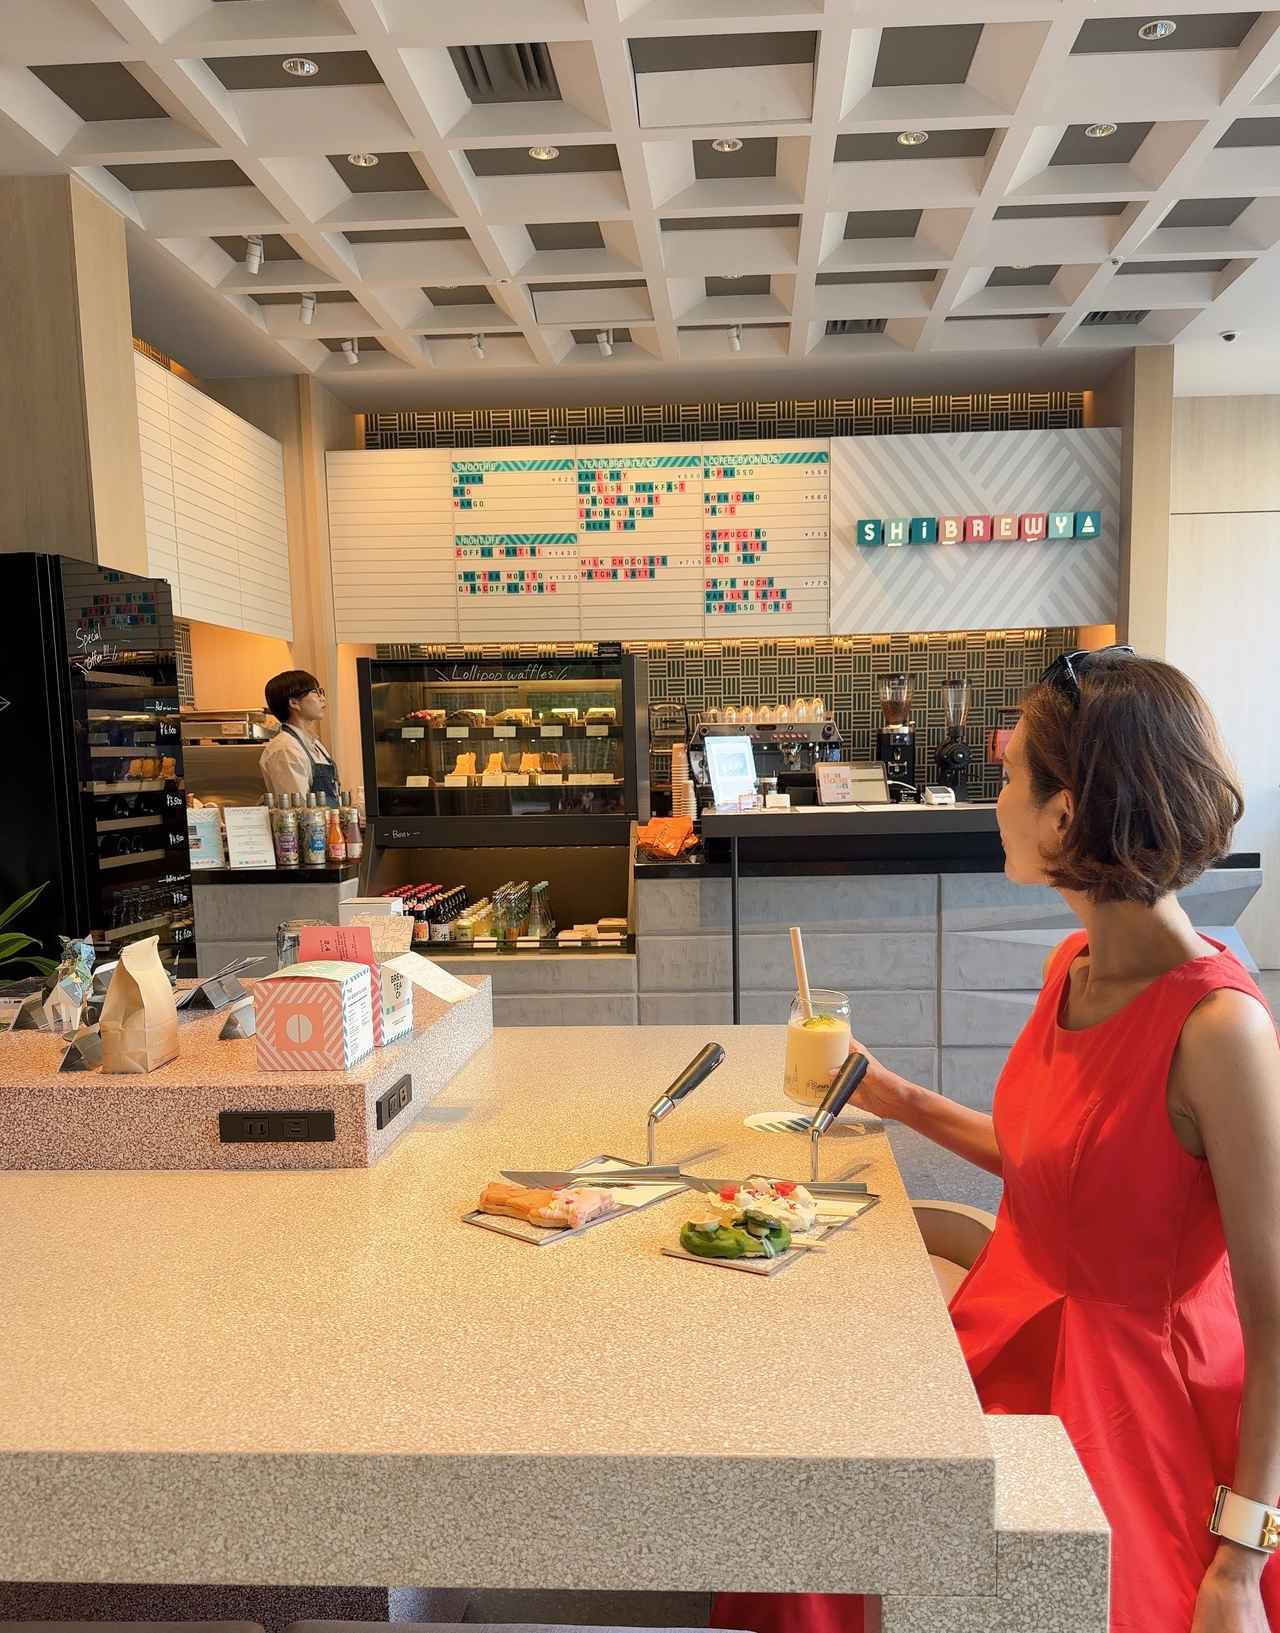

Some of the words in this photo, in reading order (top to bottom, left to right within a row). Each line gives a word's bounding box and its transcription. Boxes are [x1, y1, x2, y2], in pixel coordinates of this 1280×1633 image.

[709, 456, 738, 465] COFFEE
[704, 467, 754, 478] ESPRESSO
[453, 473, 484, 485] GREEN
[453, 486, 471, 497] RED
[578, 483, 623, 494] ENGLISH
[629, 481, 686, 493] BREAKFAST
[578, 495, 628, 506] MOROCCAN
[635, 494, 660, 506] MINT
[704, 492, 760, 503] AMERICANO
[454, 498, 484, 509] MANGO
[704, 505, 736, 516] MAGIC
[580, 520, 610, 531] GREEN
[617, 519, 636, 531] TEA
[705, 528, 767, 540] CAPPUCCINO
[456, 546, 493, 557] COFFEE
[499, 546, 543, 557] MARTINI
[735, 541, 767, 552] LATTE
[580, 557, 604, 567] MILK
[611, 556, 668, 567] CHOCOLATE
[705, 554, 729, 565] COLD
[736, 553, 761, 564] BREW
[506, 570, 543, 581] MOJITO
[580, 568, 618, 579] MATCHA
[624, 568, 655, 579] LATTE
[705, 578, 736, 589] CAFFE
[743, 577, 774, 588] MOCHA
[705, 590, 749, 601] VANILLA
[755, 589, 786, 600] LATTE
[705, 602, 755, 613] ESPRESSO
[760, 601, 792, 612] TONIC
[451, 664, 501, 681] Lollipop
[506, 663, 554, 681] waffles
